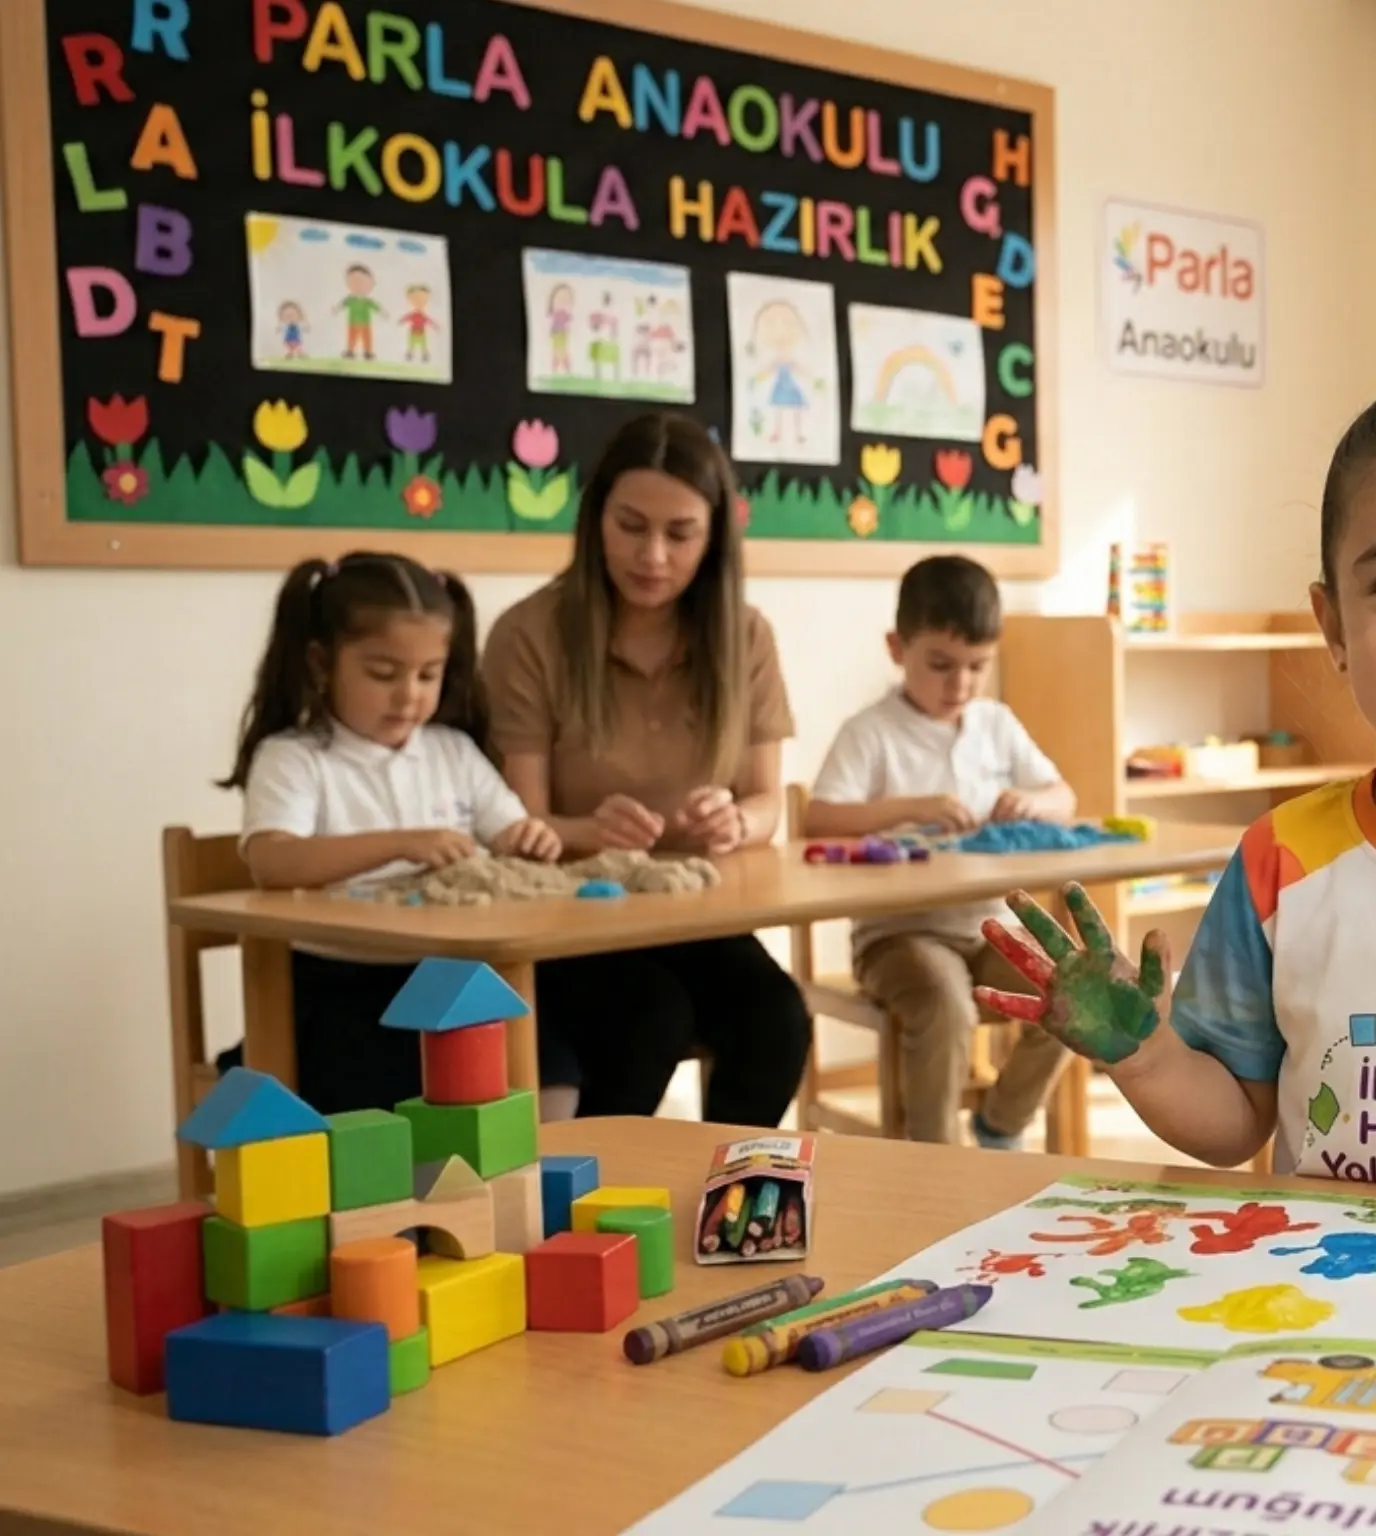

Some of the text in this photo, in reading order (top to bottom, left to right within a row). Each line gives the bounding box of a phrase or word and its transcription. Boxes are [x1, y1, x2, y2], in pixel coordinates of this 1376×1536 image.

[131, 0, 190, 61] R
[61, 33, 136, 106] R
[253, 0, 940, 182] PARLA ANAOKULU
[130, 102, 198, 180] A
[993, 130, 1030, 187] H
[63, 142, 128, 212] L
[250, 88, 943, 275] İLKOKULA HAZIRLIK
[135, 205, 193, 276] B
[996, 231, 1035, 288] D
[1145, 233, 1255, 301] Parla
[66, 266, 137, 337] D
[971, 272, 1006, 330] E
[148, 311, 201, 383] T
[997, 342, 1034, 397] C
[1117, 318, 1257, 370] Anaokulu
[981, 413, 1022, 470] G
